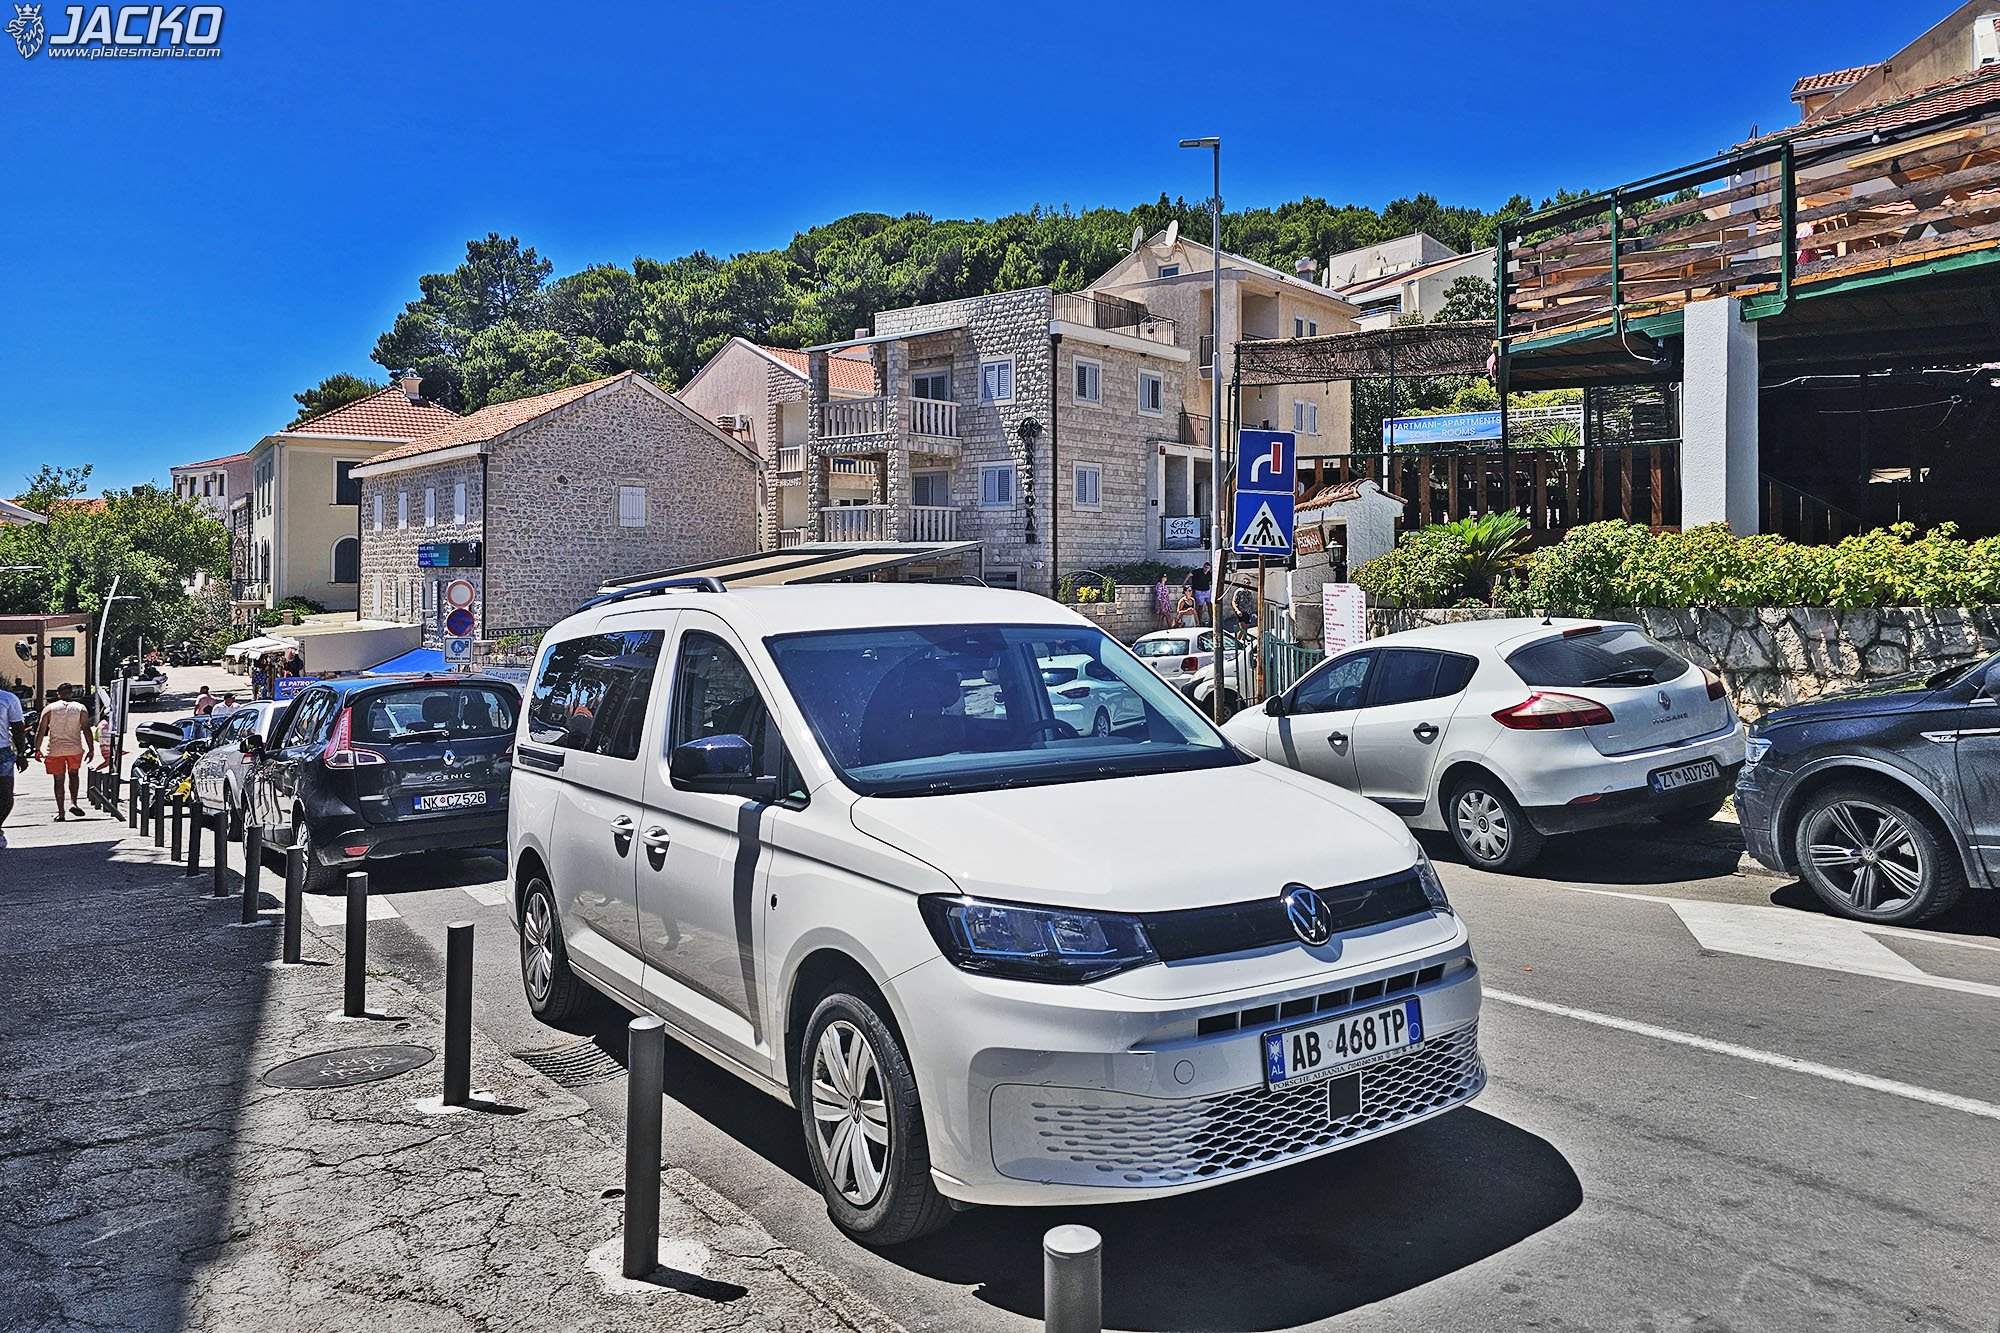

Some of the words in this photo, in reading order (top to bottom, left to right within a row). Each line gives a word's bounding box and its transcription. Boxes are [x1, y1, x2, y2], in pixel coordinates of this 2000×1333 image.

[1441, 427, 1476, 437] ROOMS
[1652, 712, 1689, 725] MEGANE
[426, 772, 472, 782] SCENIC
[1658, 771, 1677, 788] ZT
[1681, 761, 1715, 784] AD797
[423, 796, 439, 809] NK
[446, 792, 486, 807] CZ526
[1292, 1031, 1322, 1073] AB
[1335, 1016, 1377, 1058] 468
[1378, 1008, 1405, 1046] TP
[1271, 1065, 1284, 1076] AL
[1273, 1075, 1312, 1090] PORSCHE
[1312, 1066, 1347, 1080] ALBANIA
